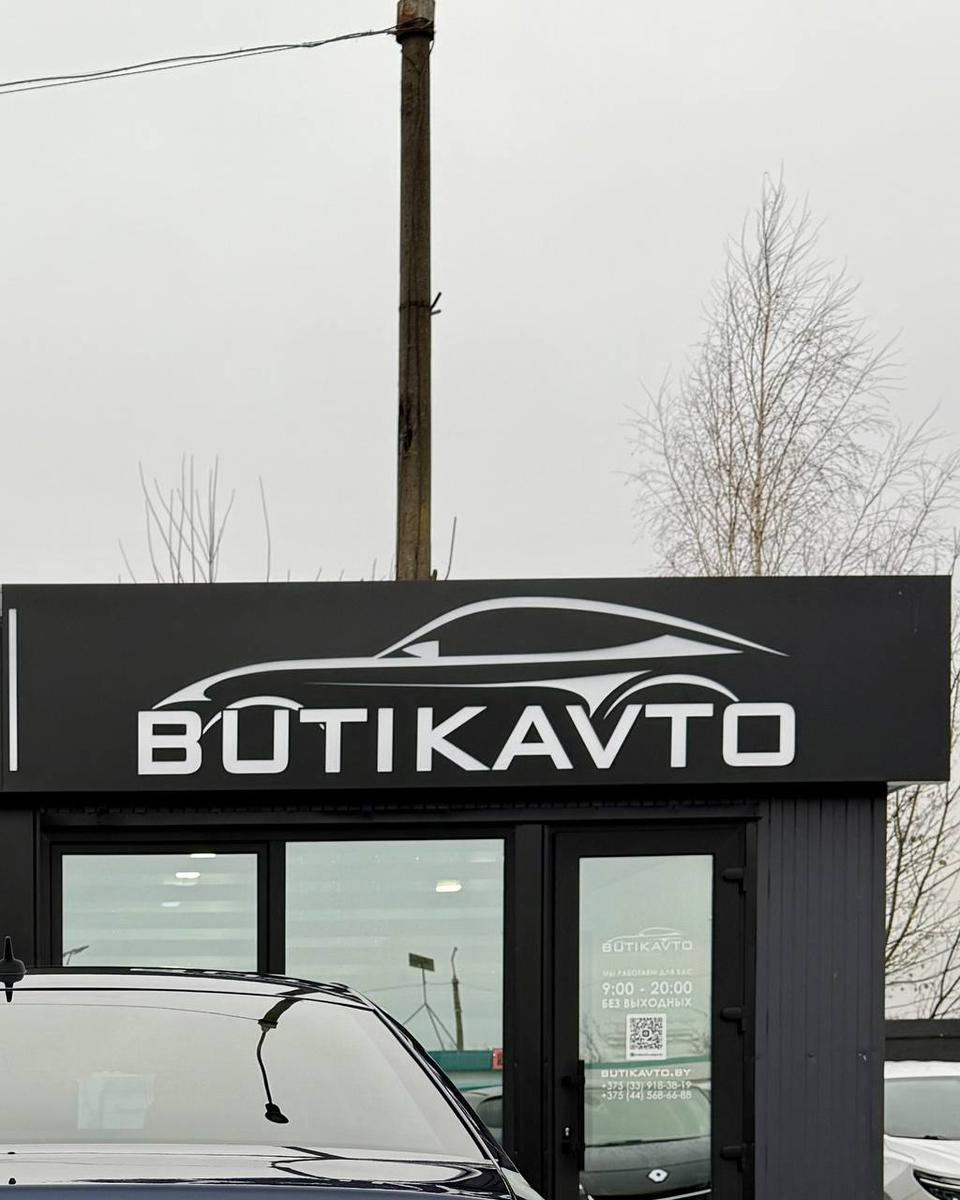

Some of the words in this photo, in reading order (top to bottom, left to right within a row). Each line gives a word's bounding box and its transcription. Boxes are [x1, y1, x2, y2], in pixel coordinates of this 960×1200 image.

[138, 702, 796, 775] BUTIKAVTO
[602, 940, 693, 952] BUTIKAVTO
[602, 982, 634, 996] 9:00
[650, 981, 692, 995] 20:00
[602, 998, 620, 1008] БЕЗ
[623, 997, 693, 1009] ВЫХОДНЫХ
[601, 1068, 692, 1078] BUTIKAVTO.BY
